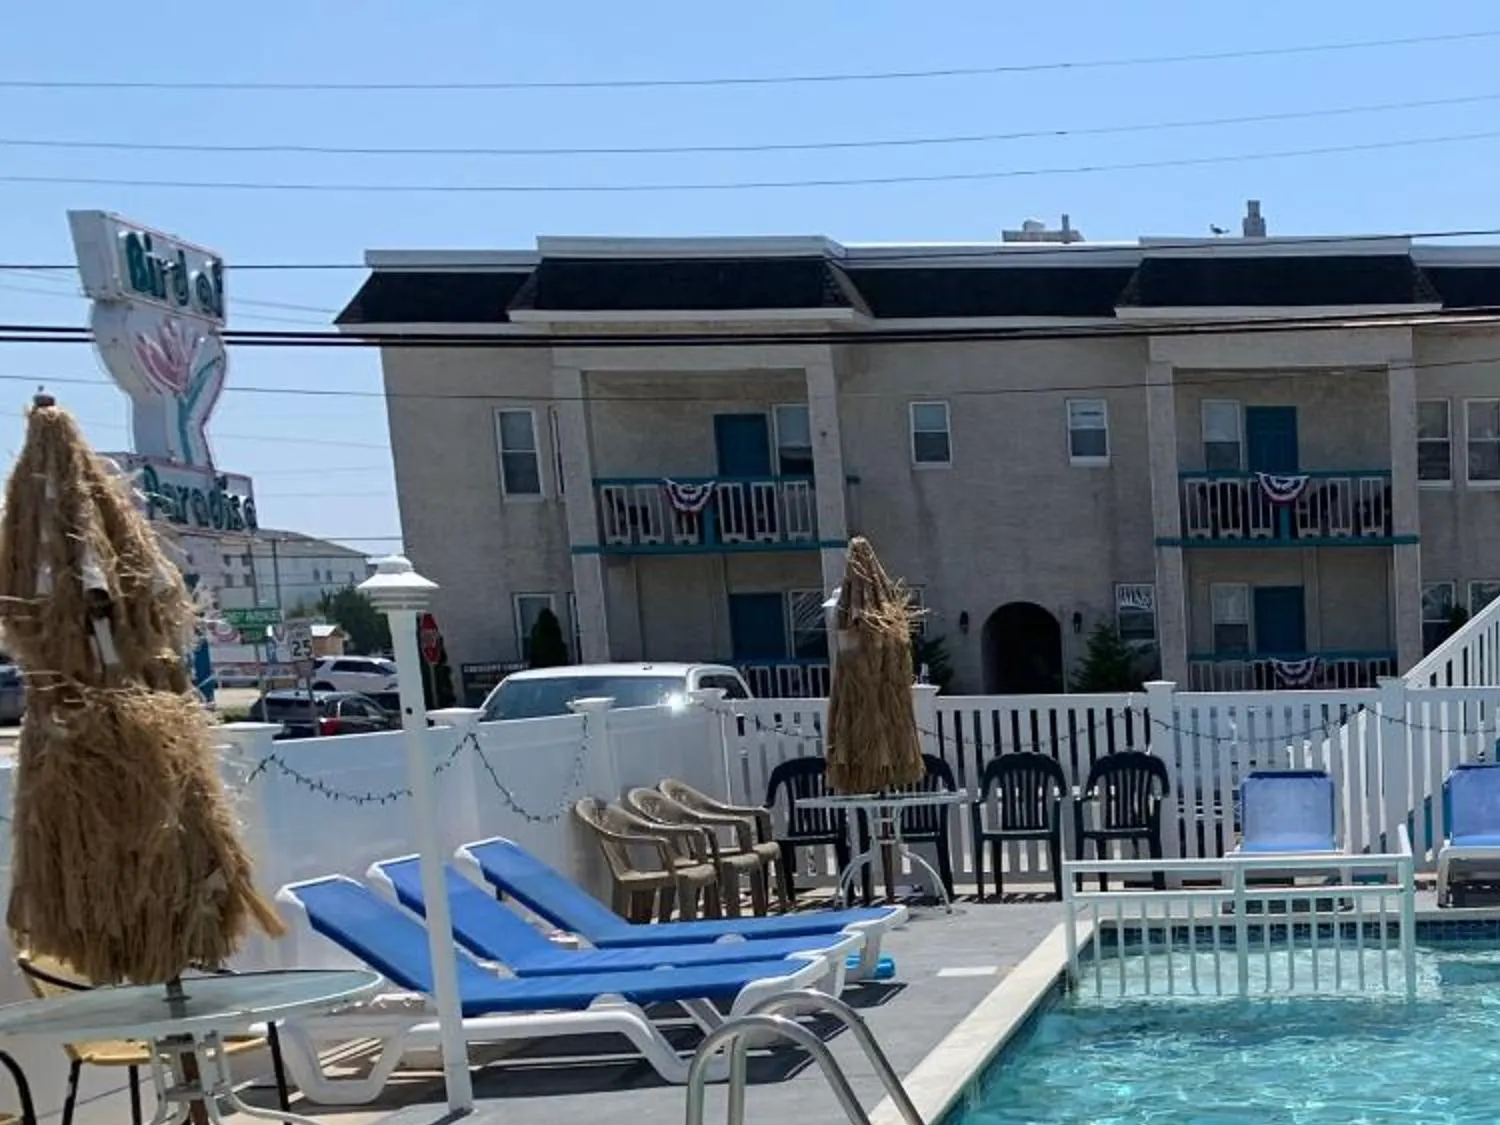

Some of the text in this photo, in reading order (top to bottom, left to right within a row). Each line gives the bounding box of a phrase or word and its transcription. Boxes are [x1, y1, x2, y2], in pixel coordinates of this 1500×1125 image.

[126, 232, 223, 319] Bird of
[143, 464, 258, 532] Paradise
[291, 639, 313, 657] 25
